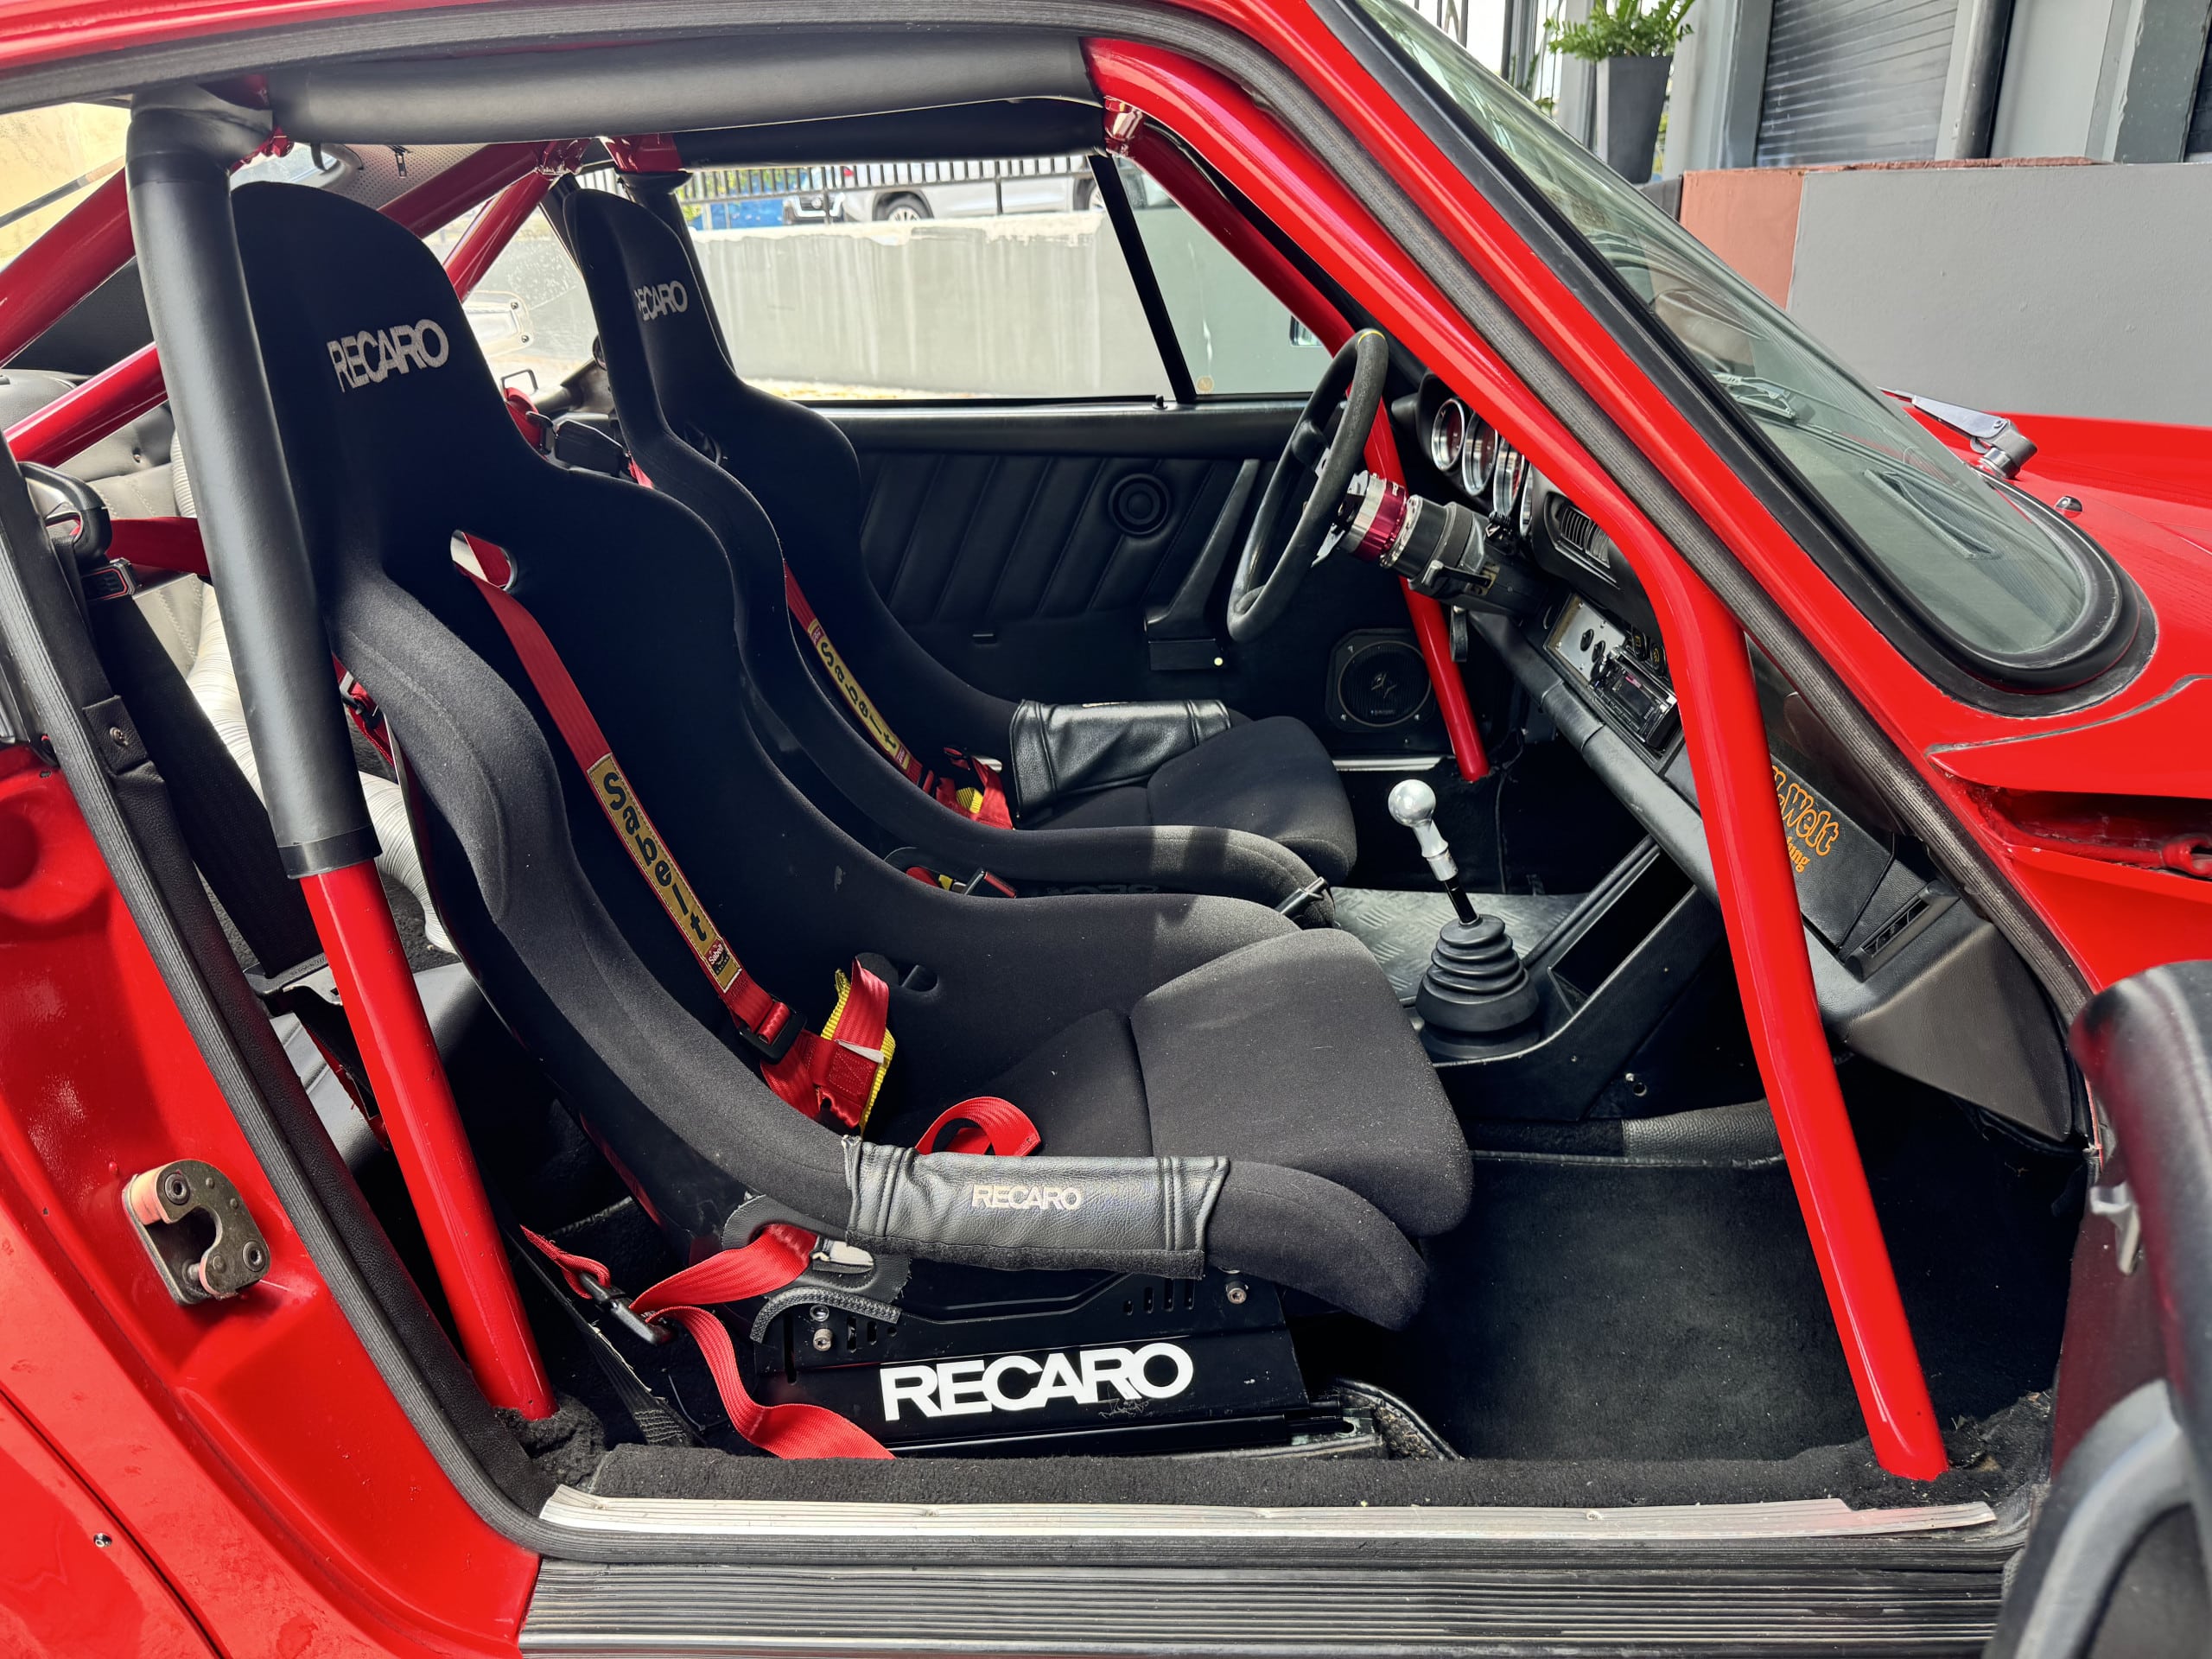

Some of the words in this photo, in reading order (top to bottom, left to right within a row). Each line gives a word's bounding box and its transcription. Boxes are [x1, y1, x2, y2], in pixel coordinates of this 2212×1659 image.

[633, 280, 689, 321] RECARO
[327, 319, 449, 393] RECARO
[821, 642, 897, 749] Sabelt
[1772, 764, 1840, 856] Welt
[603, 772, 707, 942] Sabelt
[972, 1183, 1084, 1211] RECARO
[880, 1342, 1194, 1422] RECARO
